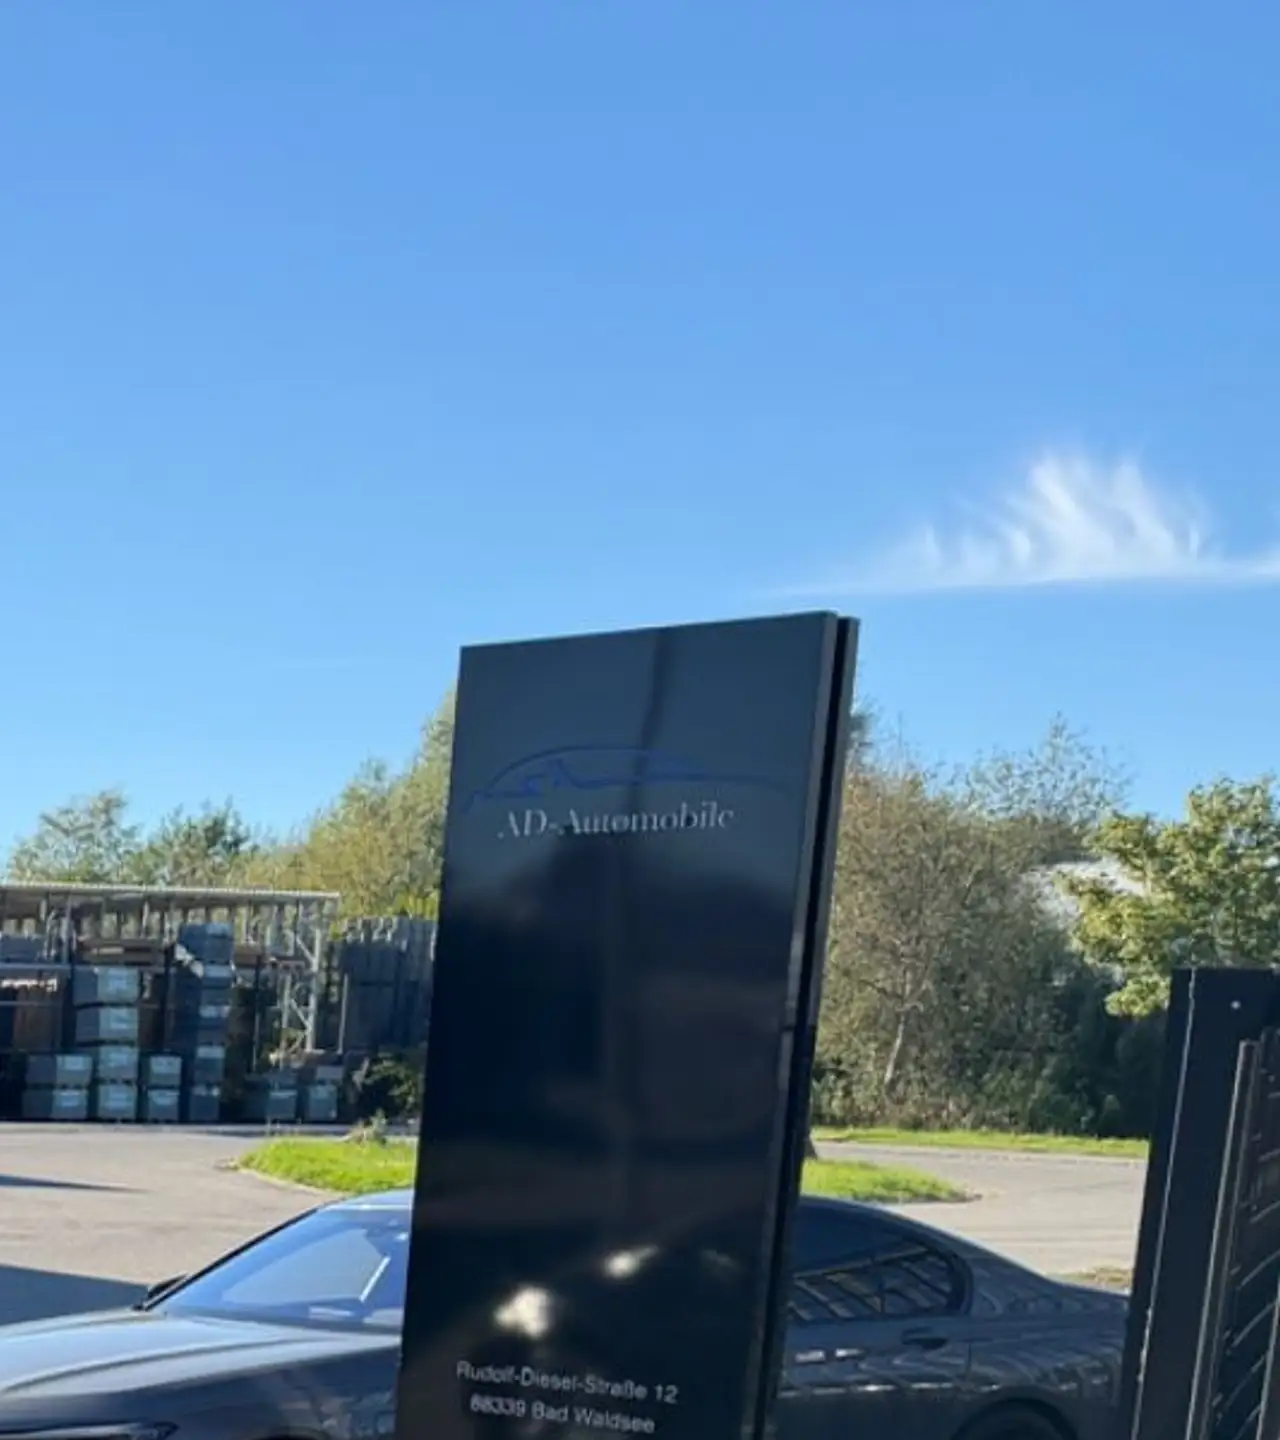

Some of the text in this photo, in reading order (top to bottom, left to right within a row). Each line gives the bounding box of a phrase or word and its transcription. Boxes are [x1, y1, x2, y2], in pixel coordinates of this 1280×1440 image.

[497, 800, 735, 839] AD-Automobile
[456, 1360, 680, 1404] Rudolf-Diesel-Straße 12
[531, 1400, 569, 1423] Bad
[573, 1406, 656, 1434] Waldsee
